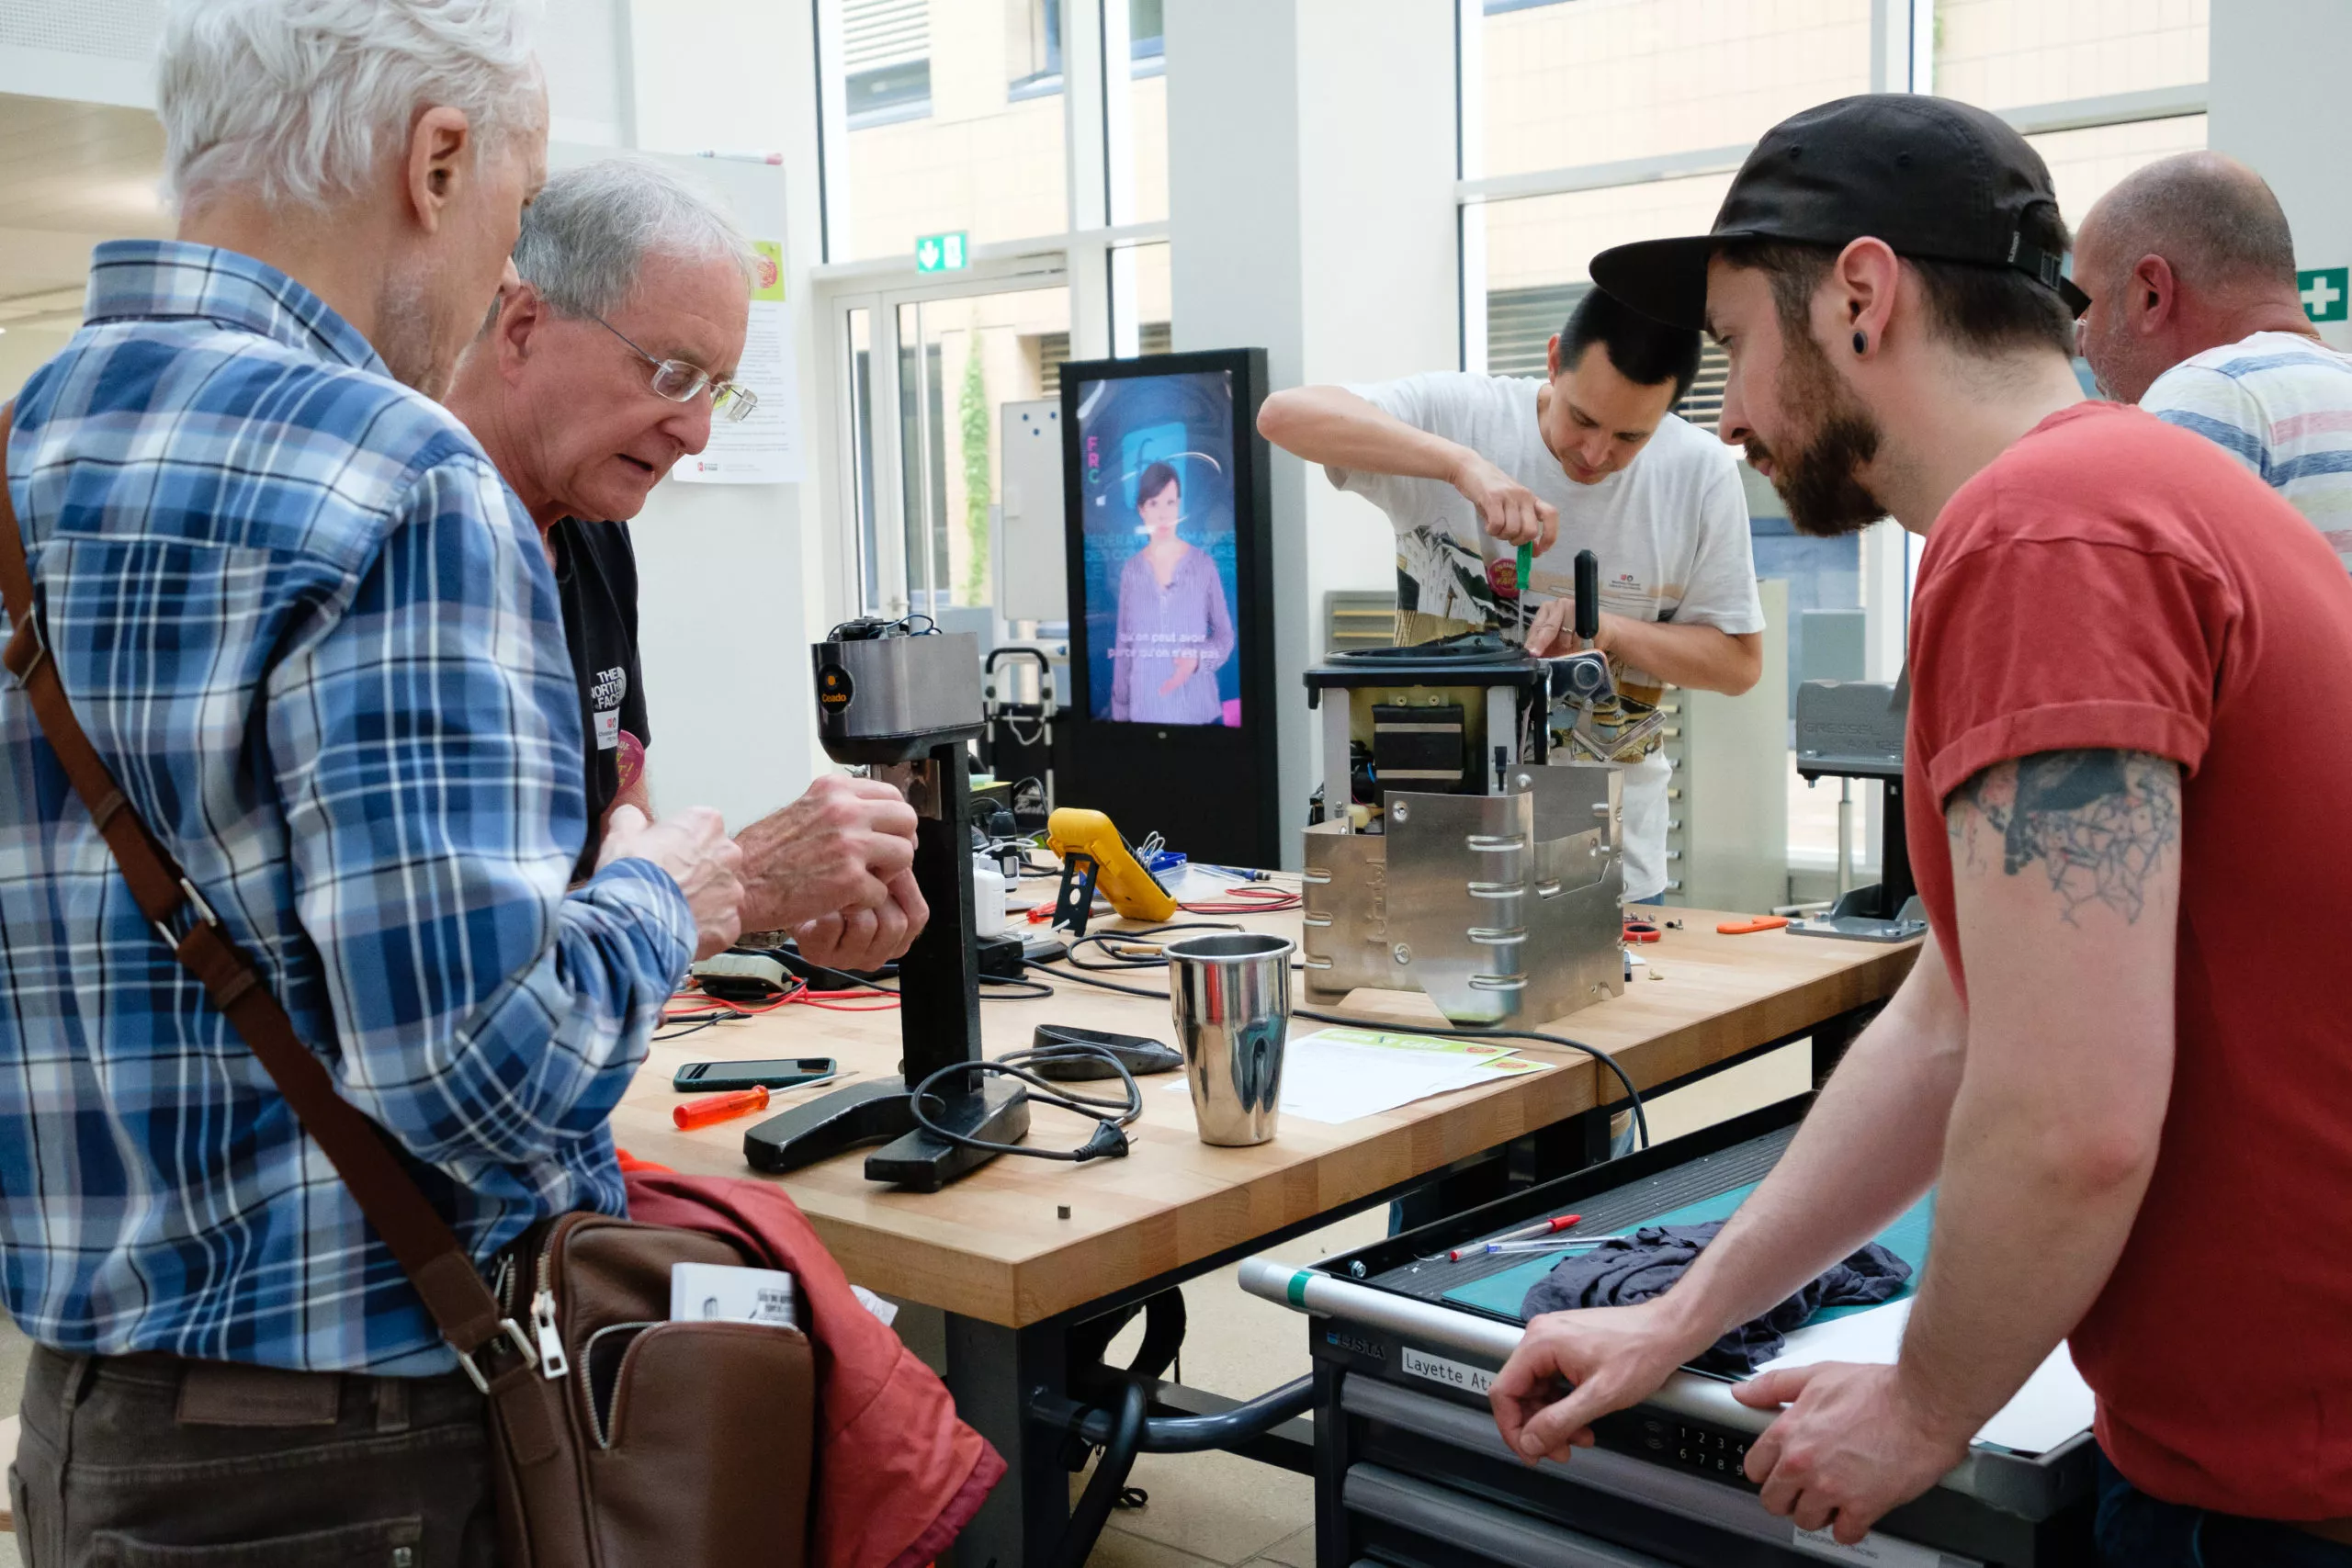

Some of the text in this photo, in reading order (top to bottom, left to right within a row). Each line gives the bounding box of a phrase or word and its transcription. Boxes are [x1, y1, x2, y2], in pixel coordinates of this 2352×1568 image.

[596, 668, 618, 683] THE
[822, 693, 846, 703] Ceado
[1340, 1334, 1386, 1360] LISTA
[1406, 1353, 1463, 1383] Layette
[1680, 1427, 1744, 1454] 1 2 3 4
[1679, 1448, 1744, 1476] 6 7 8 9
